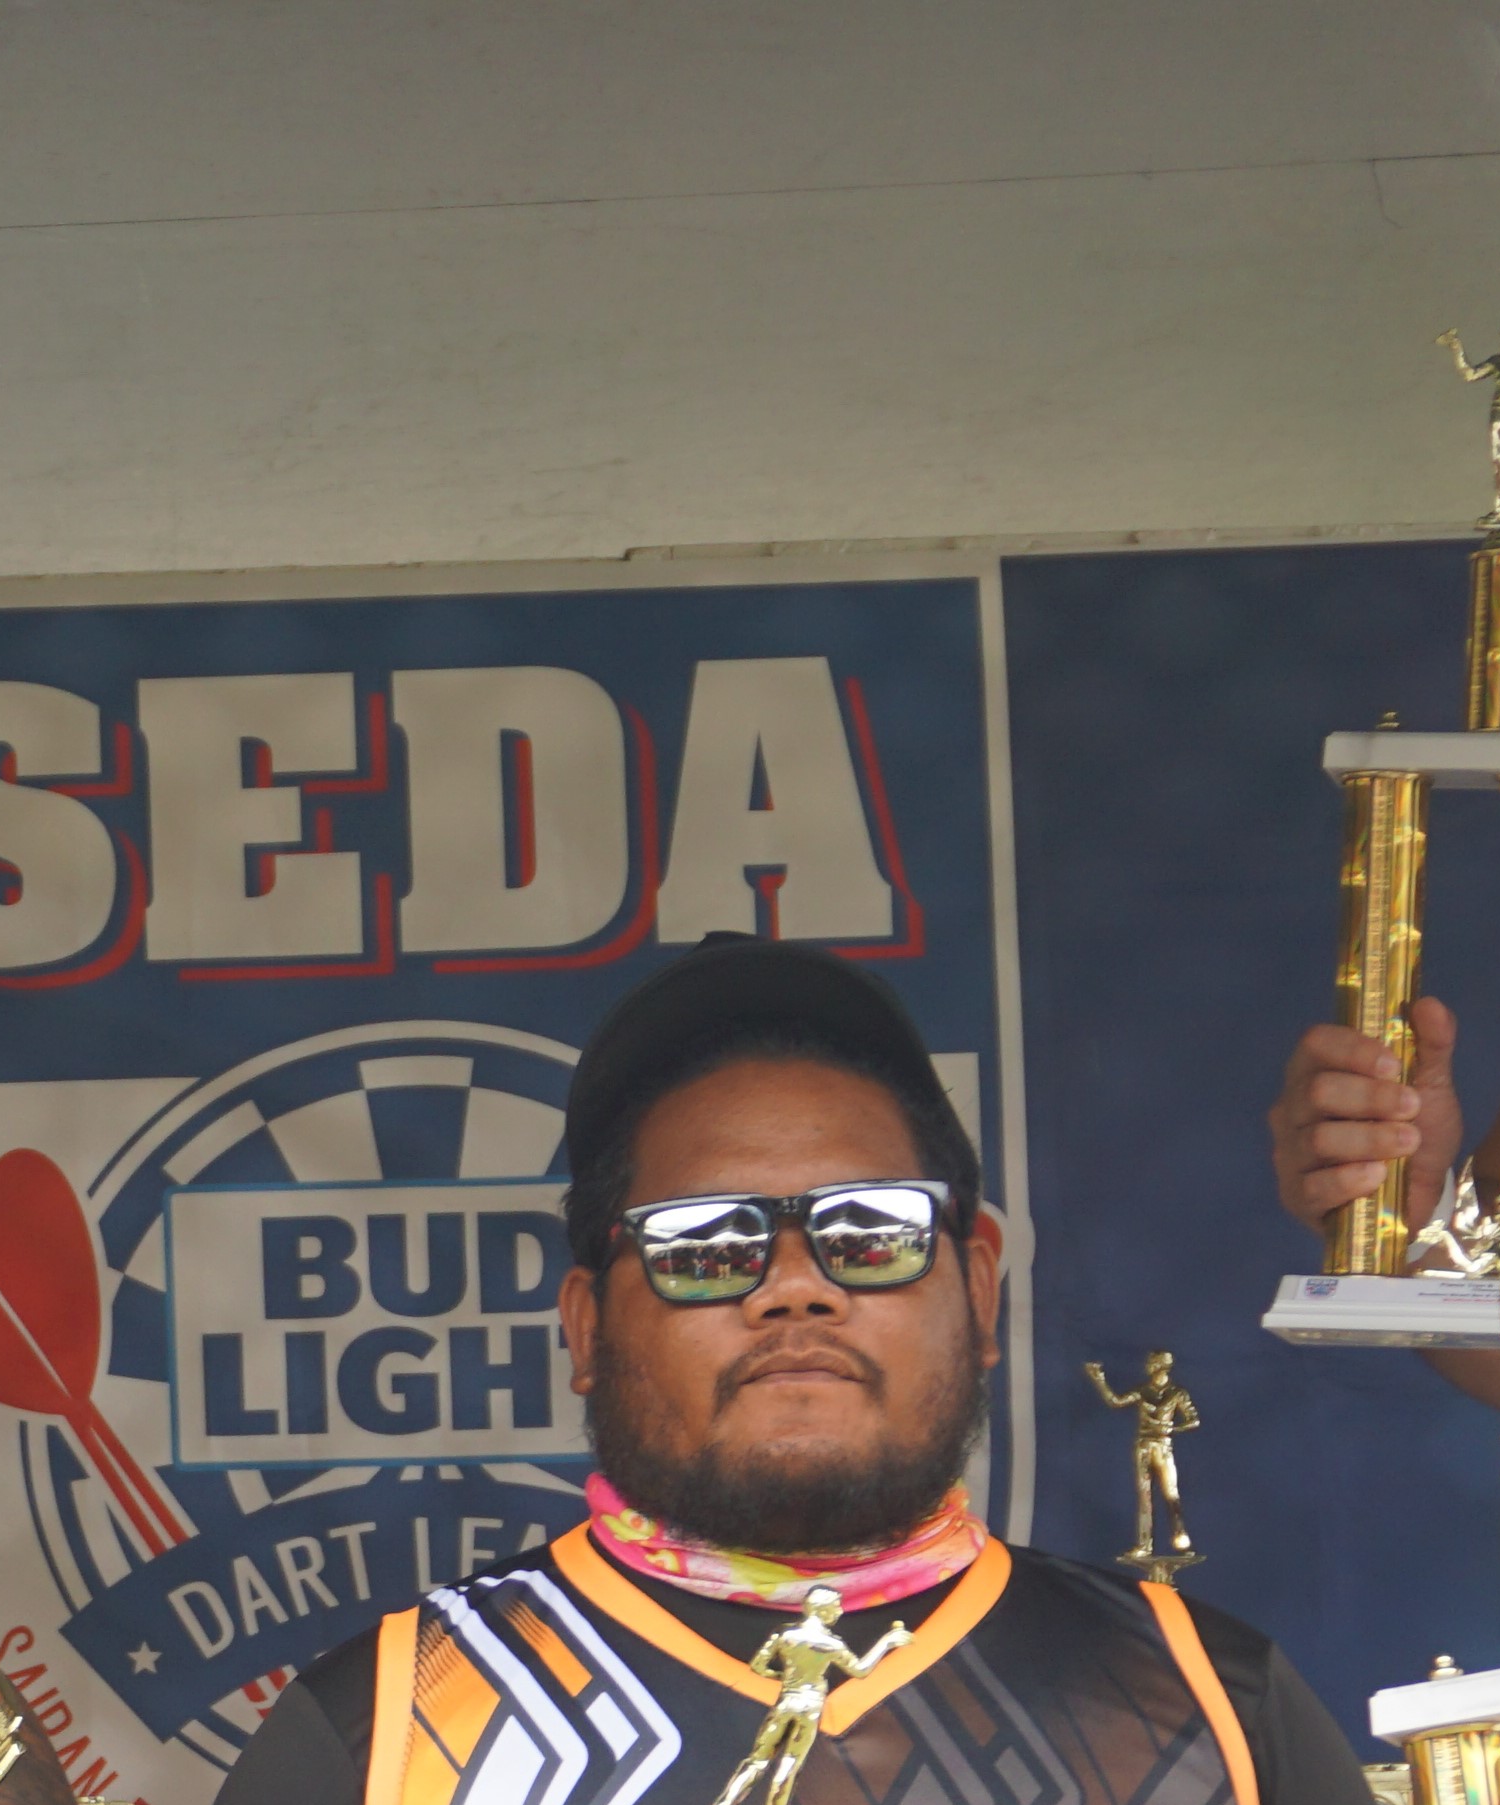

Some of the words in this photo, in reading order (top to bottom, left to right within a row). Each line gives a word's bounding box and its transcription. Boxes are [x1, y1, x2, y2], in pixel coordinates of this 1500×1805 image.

[261, 1212, 567, 1320] BUD
[202, 1329, 567, 1438] LIGH
[168, 1522, 377, 1660] DART
